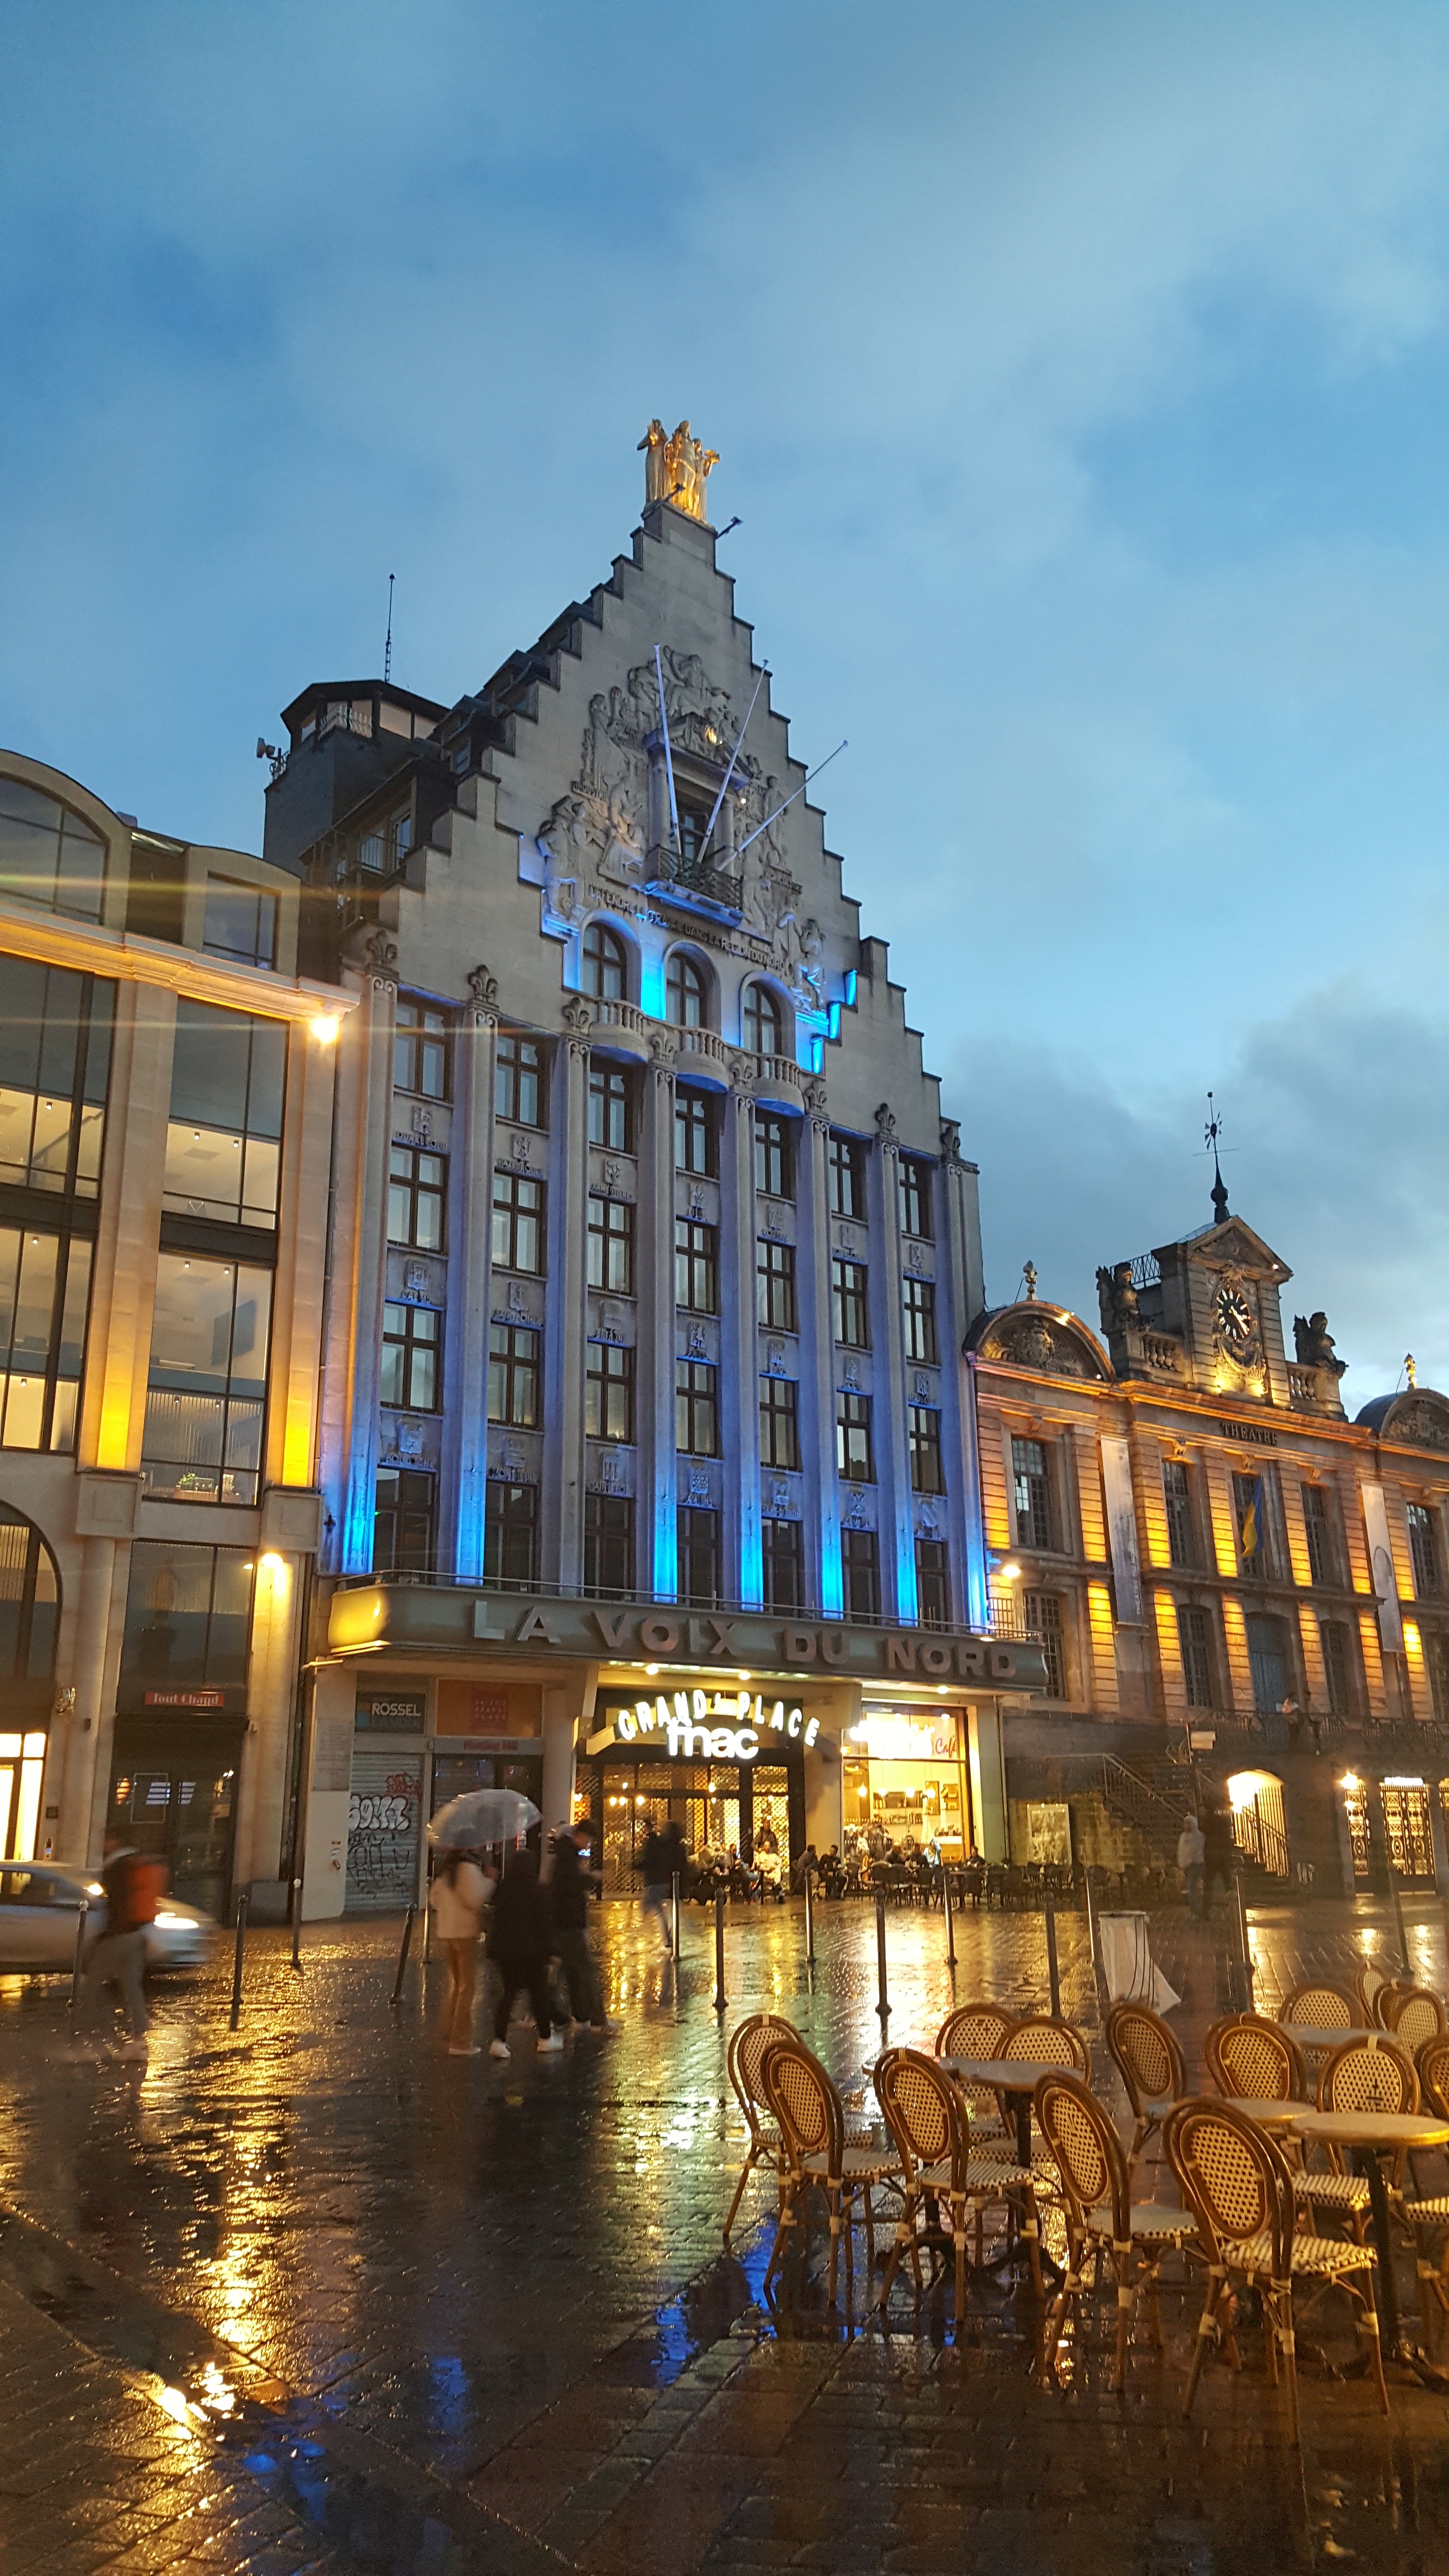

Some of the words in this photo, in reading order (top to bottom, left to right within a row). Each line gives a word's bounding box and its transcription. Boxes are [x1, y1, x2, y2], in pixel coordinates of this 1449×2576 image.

[1221, 1423, 1278, 1446] THEATRE
[473, 1600, 561, 1643] LA
[592, 1610, 741, 1657] VOIX
[784, 1628, 851, 1665] DU
[886, 1637, 1017, 1678] NORD
[371, 1703, 421, 1717] ROSSEL
[737, 1691, 820, 1747] PLACE
[667, 1716, 759, 1759] fnac
[935, 1736, 957, 1758] Café
